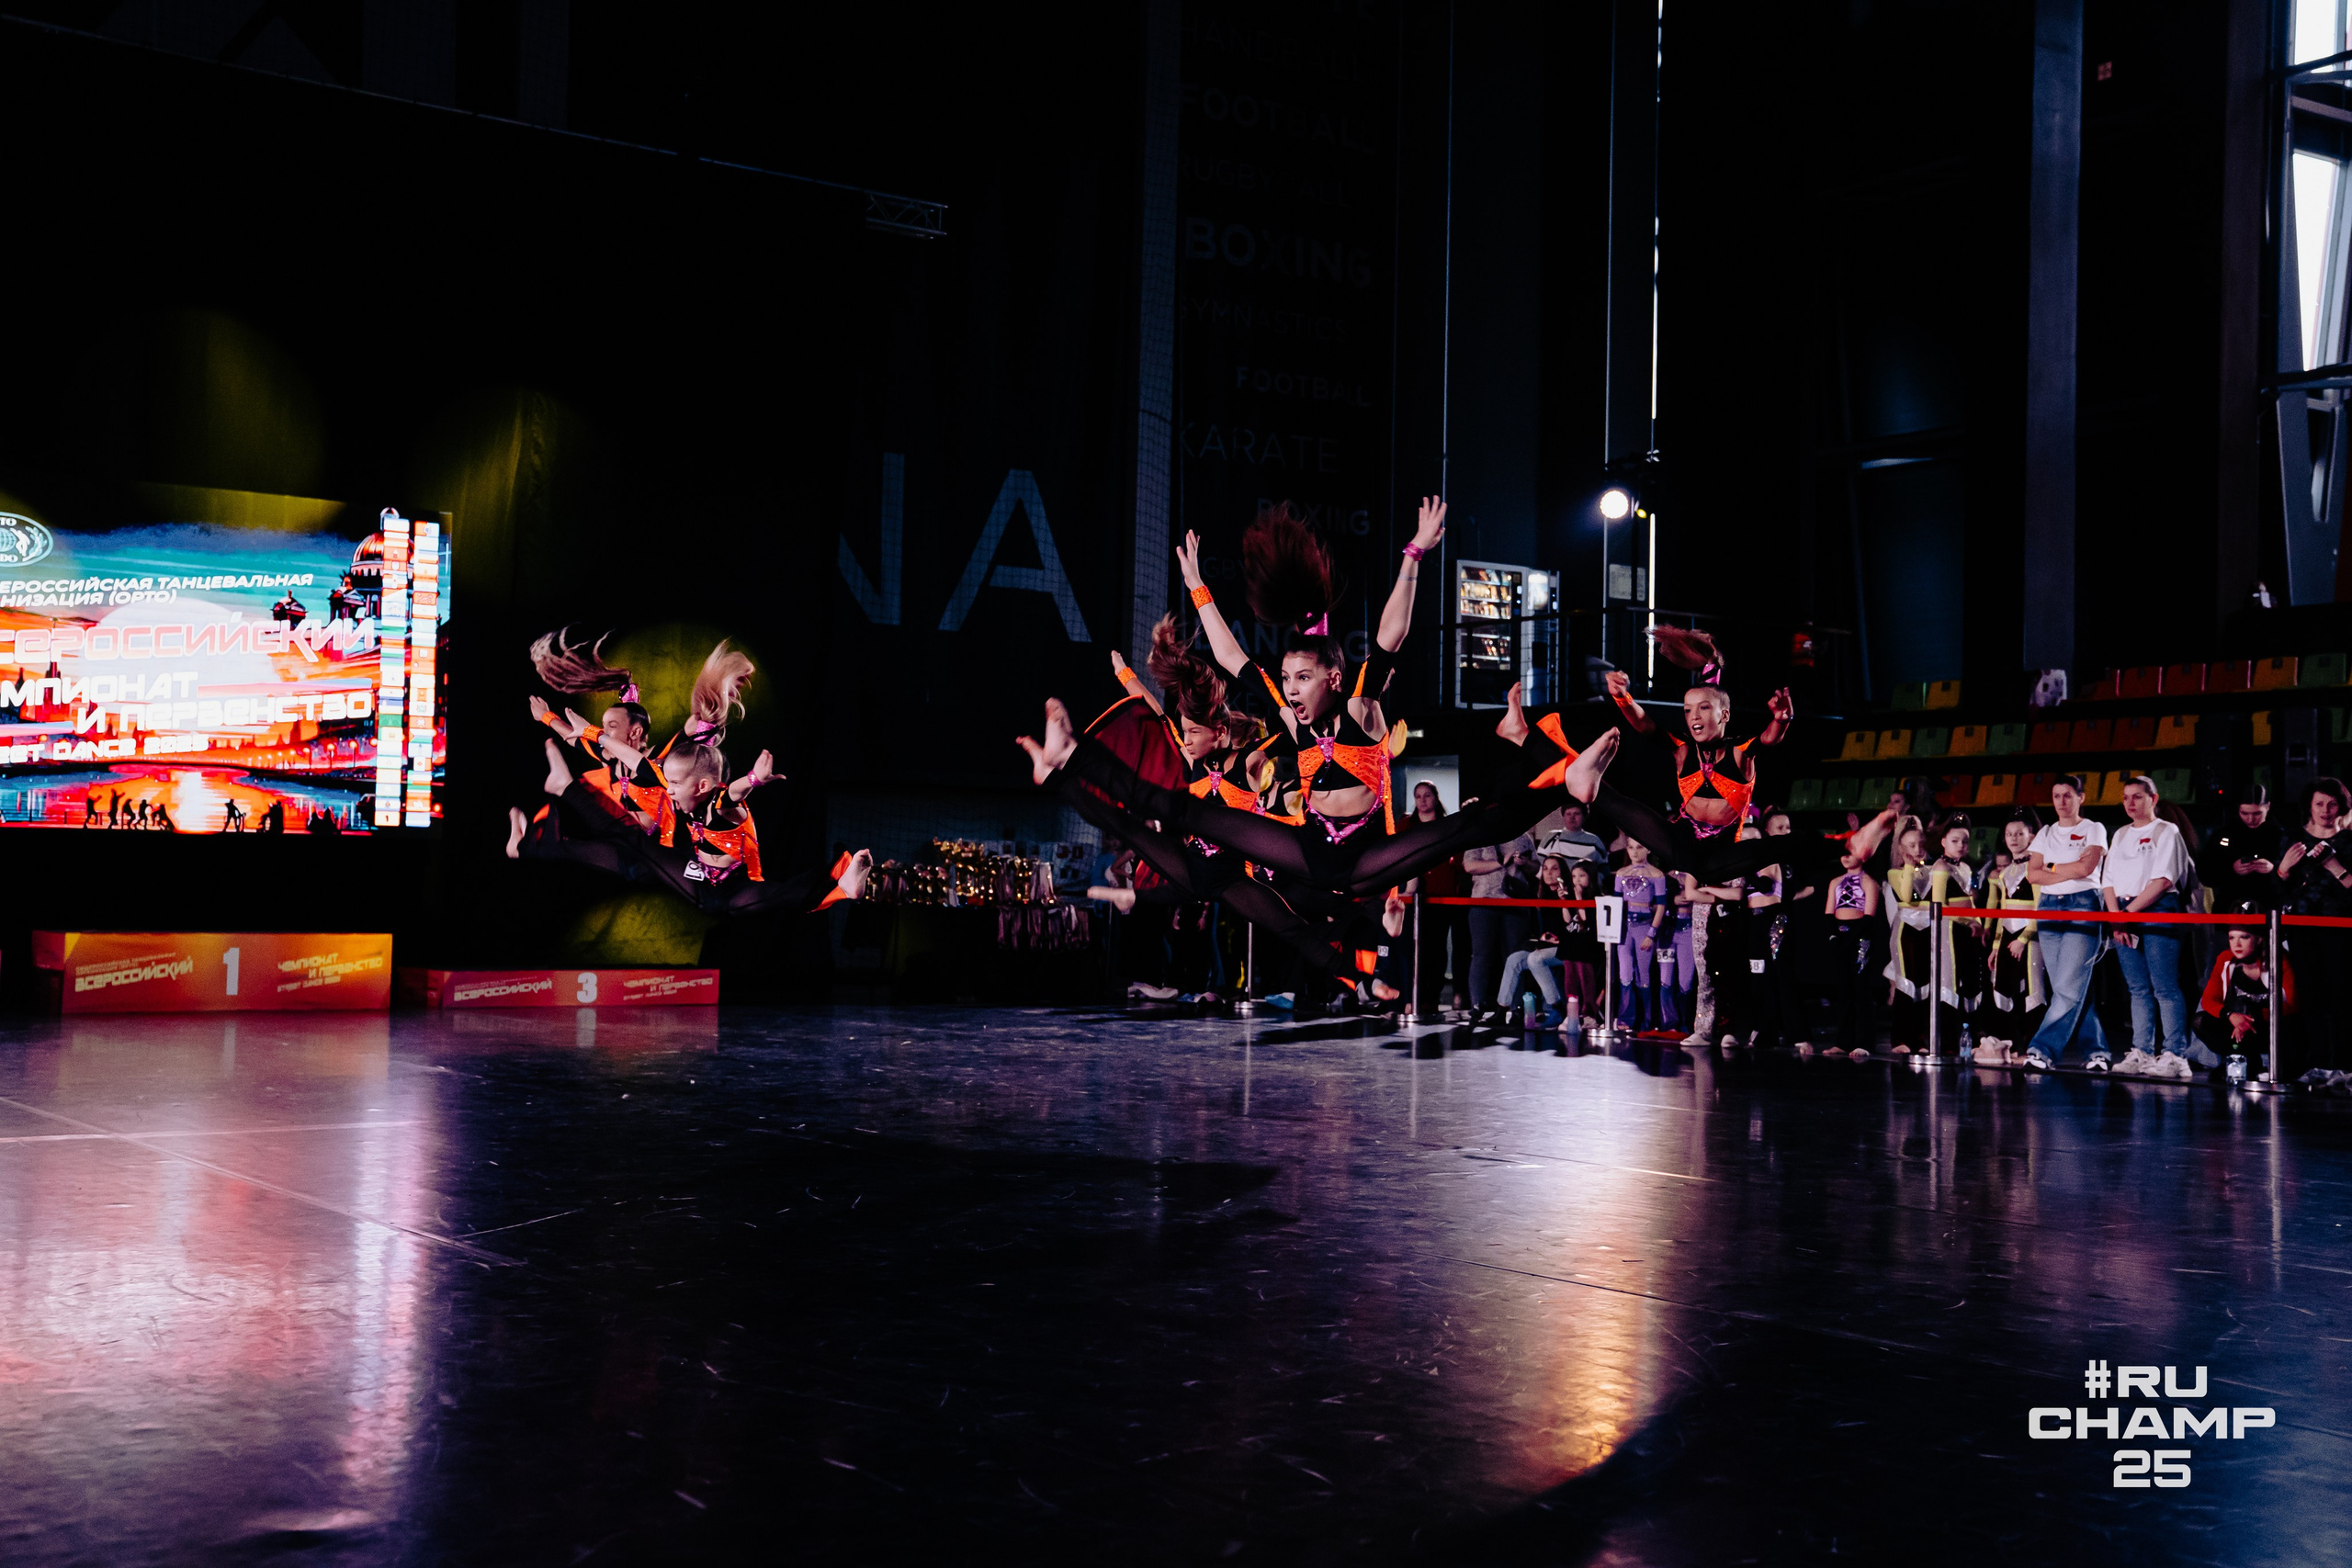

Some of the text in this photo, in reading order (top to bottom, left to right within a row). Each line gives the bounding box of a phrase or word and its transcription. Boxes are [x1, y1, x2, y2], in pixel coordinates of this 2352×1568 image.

[1184, 216, 1372, 290] BOXING
[1236, 367, 1372, 408] FOOTBALL
[1180, 421, 1339, 474] KARATE
[108, 589, 177, 606] (ОРТО)
[157, 573, 314, 591] ТАНЦЕВАЛЬНАЯ
[77, 693, 372, 734] И ПЕРВЕНСТВО
[52, 739, 136, 761] DANCE
[1603, 905, 1612, 926] 1
[75, 955, 193, 992] ВСЕРОССИЙСКИЙ
[222, 947, 240, 995] 1
[576, 972, 597, 1003] 3
